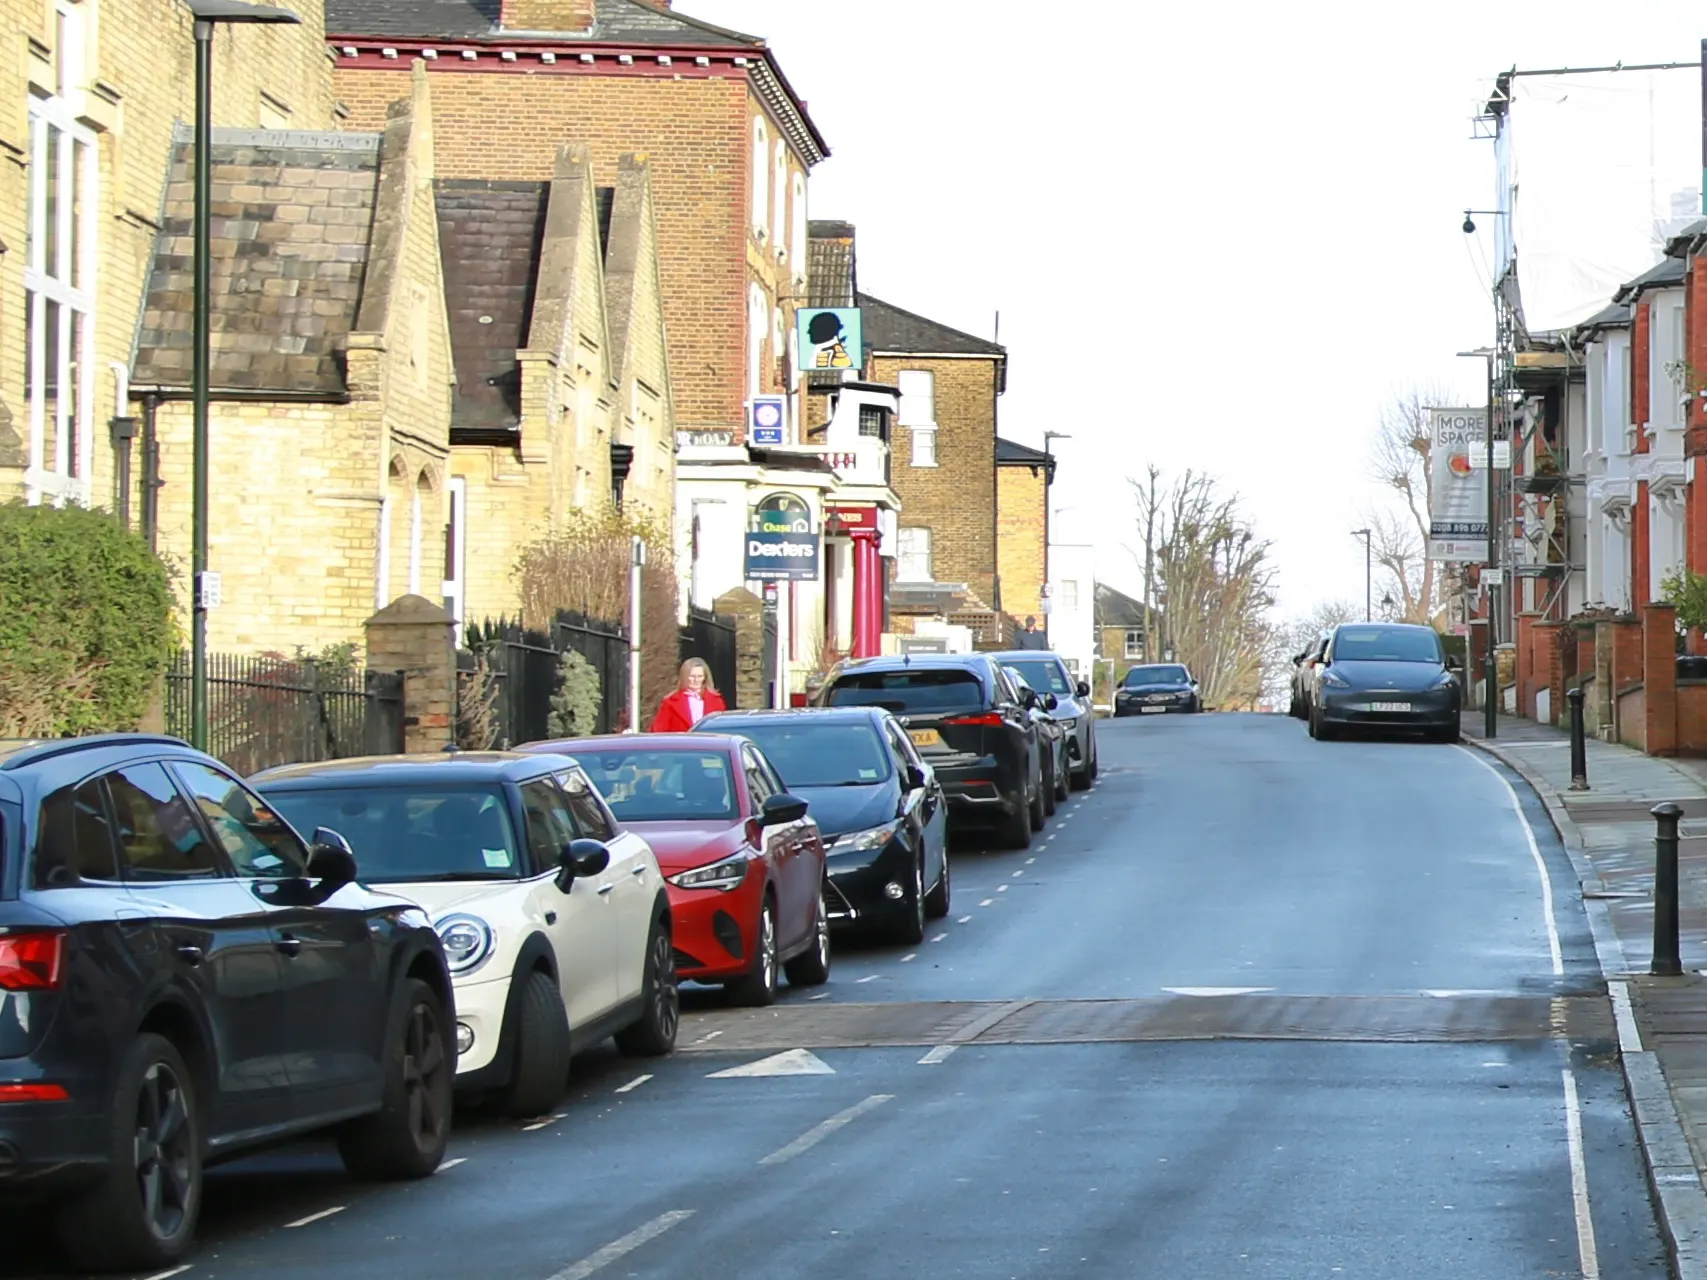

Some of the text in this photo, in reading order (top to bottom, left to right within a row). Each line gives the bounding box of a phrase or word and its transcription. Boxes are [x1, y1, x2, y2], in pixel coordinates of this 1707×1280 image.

[1440, 416, 1484, 430] MORE
[763, 522, 792, 532] Chase
[749, 540, 814, 557] Dexters
